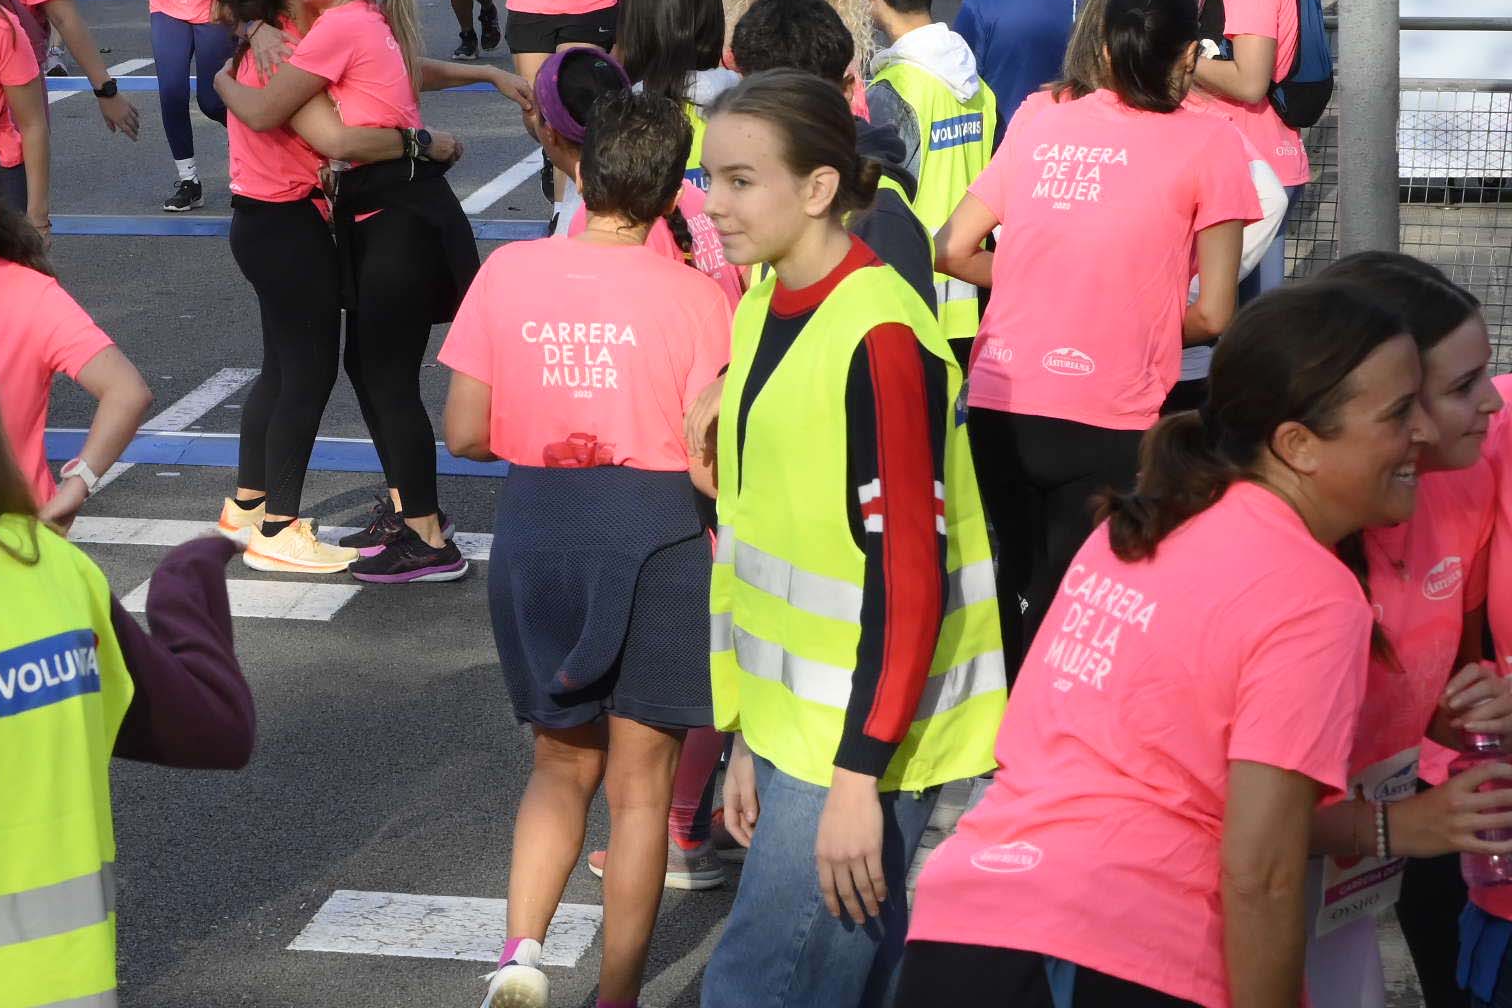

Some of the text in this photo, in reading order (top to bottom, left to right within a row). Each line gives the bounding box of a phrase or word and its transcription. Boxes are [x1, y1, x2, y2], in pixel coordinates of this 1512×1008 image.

[1032, 143, 1129, 166] CARRERA
[1041, 162, 1100, 182] DE LA
[1031, 180, 1101, 202] MUJER
[521, 321, 637, 347] CARRERA
[544, 344, 614, 366] DE LA
[542, 366, 619, 389] MUJER
[1064, 564, 1157, 634] CARRERA
[1062, 602, 1123, 656] DE LA
[1043, 634, 1113, 691] MUJER
